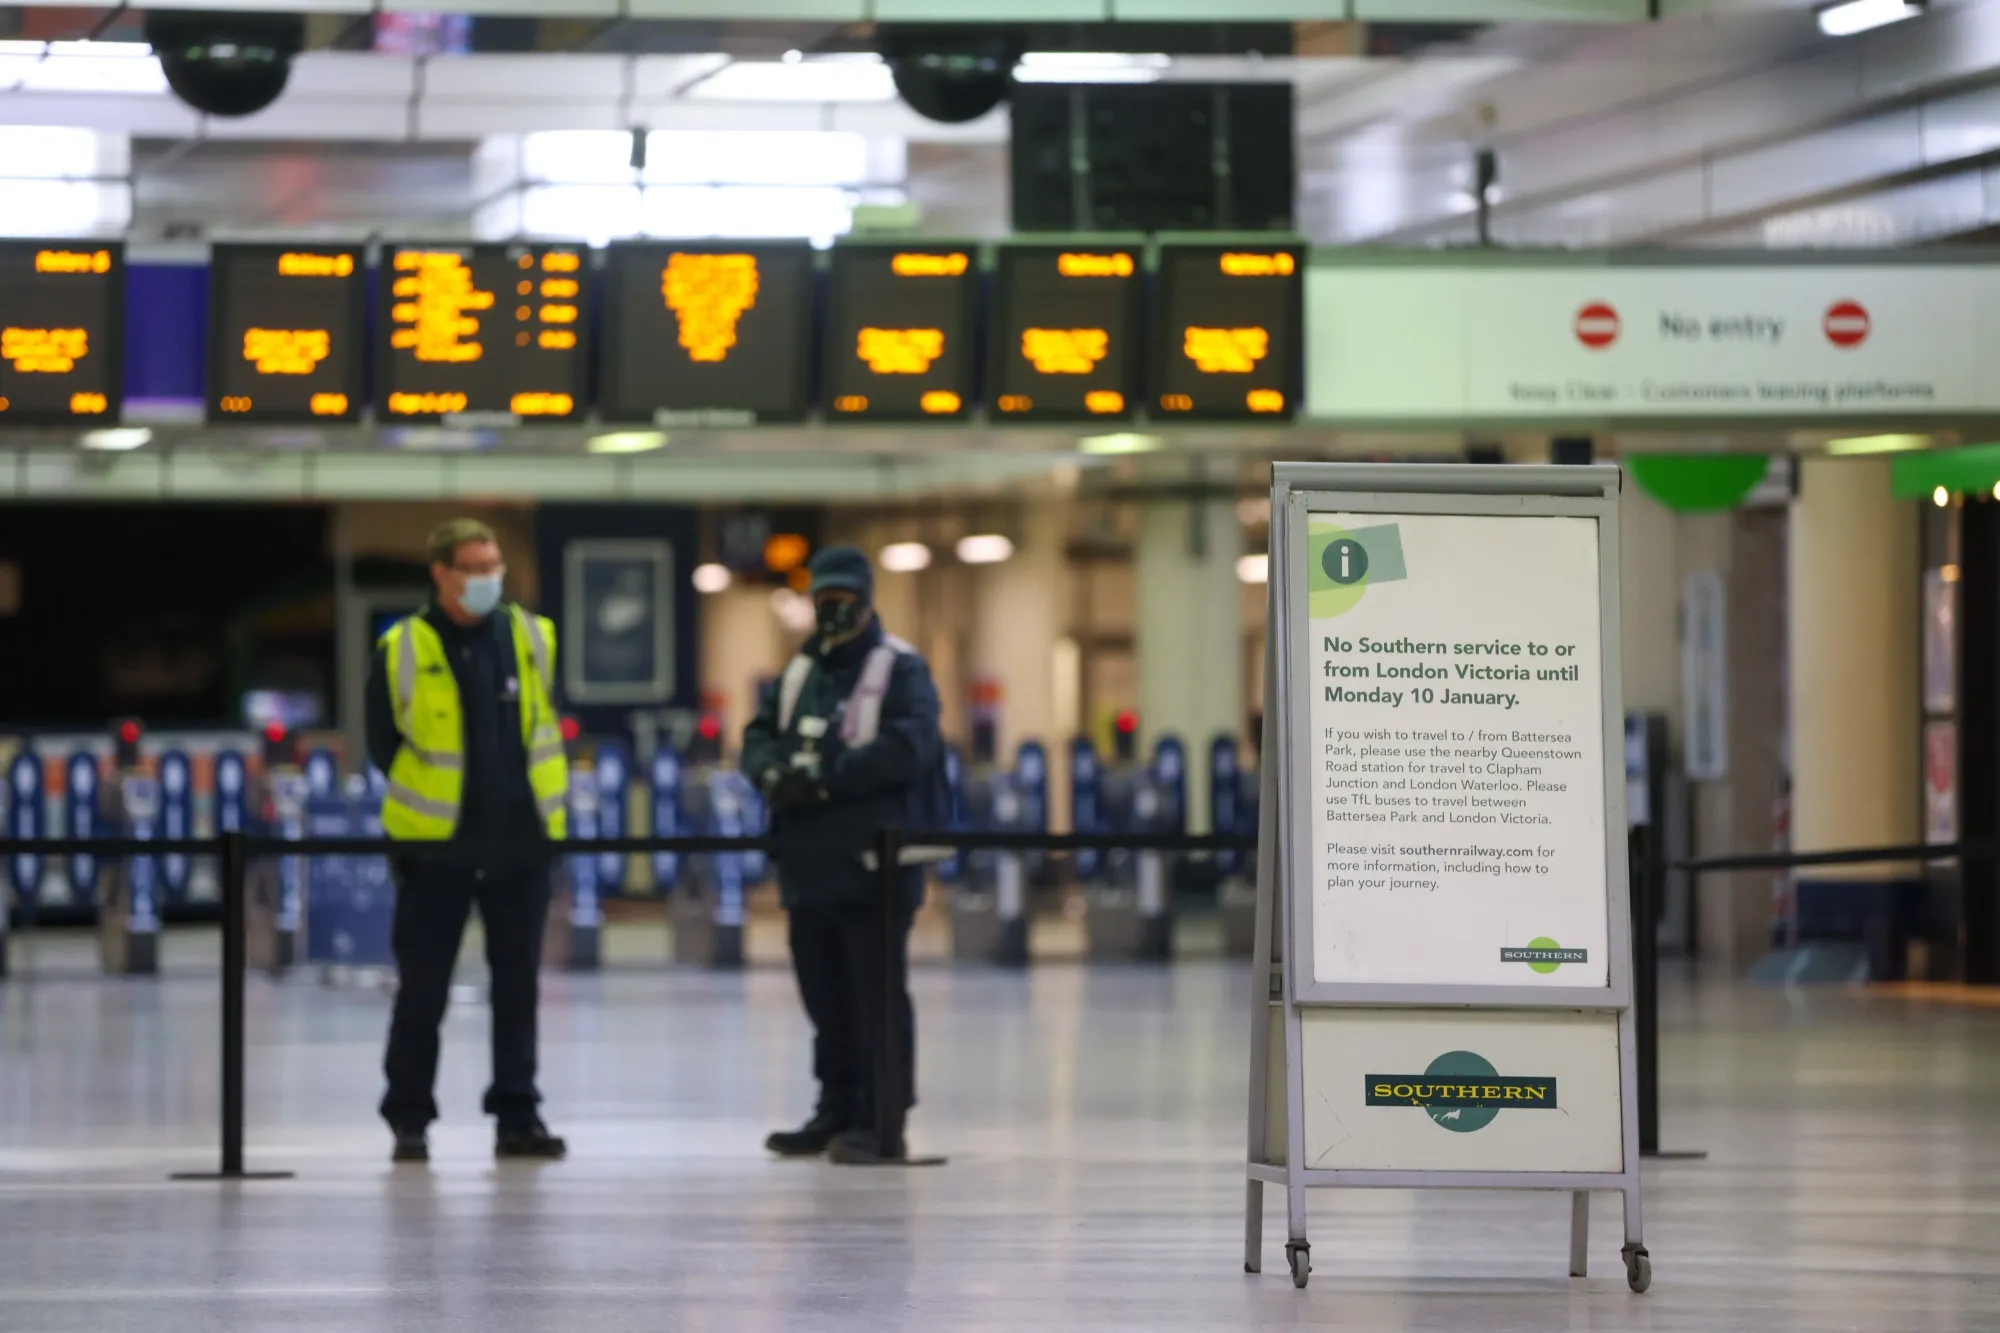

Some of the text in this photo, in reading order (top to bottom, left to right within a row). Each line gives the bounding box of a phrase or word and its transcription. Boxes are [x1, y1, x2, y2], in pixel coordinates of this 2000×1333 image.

[1659, 309, 1784, 347] No entry
[1640, 379, 1750, 401] Customers
[1756, 380, 1831, 405] leaving
[1834, 380, 1936, 405] platforms
[1323, 636, 1576, 657] No Southern service to or
[1323, 659, 1579, 682] from London Victoria until
[1324, 685, 1520, 711] Monday 10 January.
[1325, 726, 1334, 739] If
[1336, 730, 1360, 742] you
[1363, 728, 1391, 740] wish
[1394, 730, 1409, 741] to
[1411, 729, 1448, 741] travel
[1451, 731, 1465, 741] to
[1477, 729, 1508, 742] from
[1512, 730, 1572, 743] Battersea
[1325, 743, 1582, 761] Park, please use the nearby Queenstown
[1325, 760, 1542, 779] Road station for travel to Clapham
[1325, 776, 1568, 792] Junction and London Waterloo. Please
[1326, 792, 1527, 808] use TfL buses to travel between
[1326, 809, 1552, 825] Battersea Park and London Victoria.
[1327, 842, 1556, 861] Please visit southernrailway.com for
[1327, 859, 1549, 877] more information, including how to
[1327, 875, 1440, 892] plan your journey.
[1504, 951, 1584, 960] SOUTHERN
[1374, 1084, 1547, 1100] SOUTHERN
